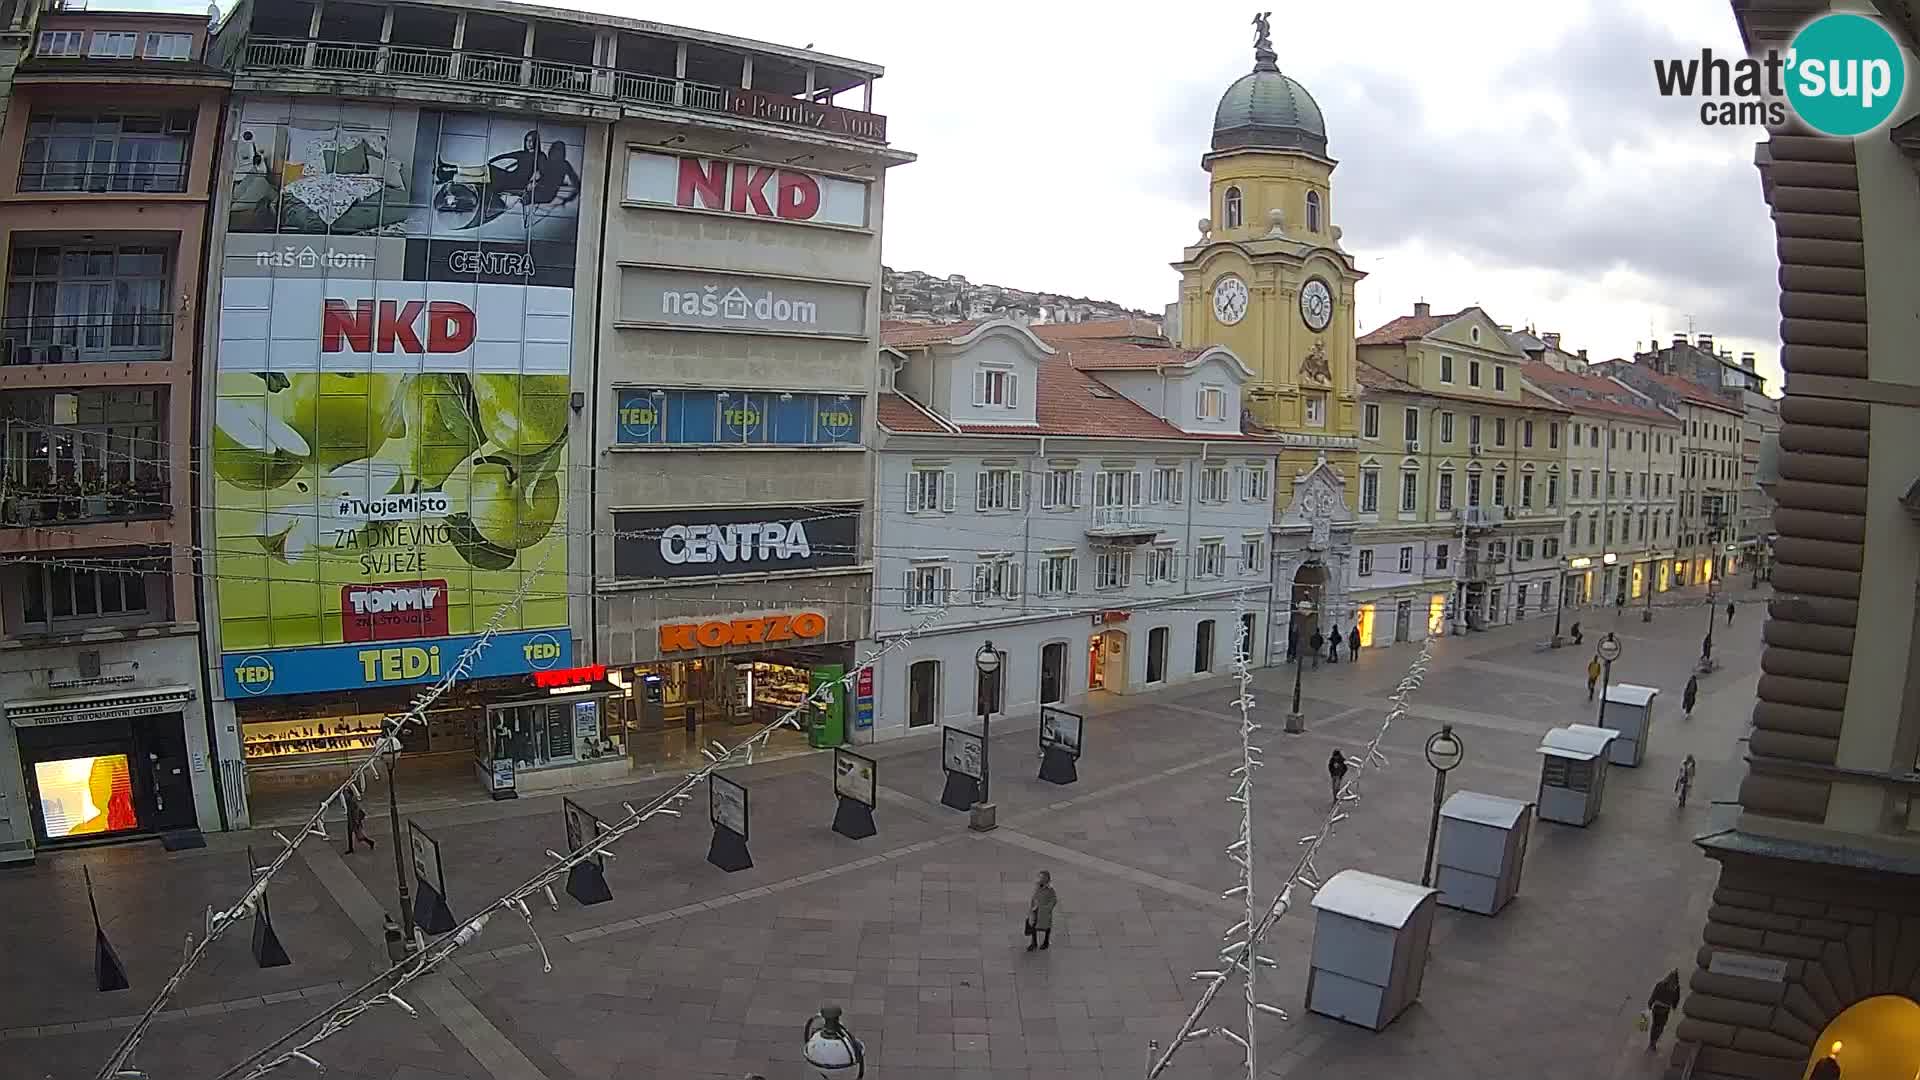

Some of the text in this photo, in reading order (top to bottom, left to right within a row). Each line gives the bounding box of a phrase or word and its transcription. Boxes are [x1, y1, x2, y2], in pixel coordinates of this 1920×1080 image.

[724, 90, 746, 112] Le
[676, 158, 821, 221] NKD
[256, 245, 367, 271] naš dom
[448, 250, 537, 277] CENTRA
[663, 284, 817, 324] naš dom
[321, 298, 478, 354] NKD
[619, 408, 658, 426] TEDi
[724, 408, 761, 426] TEDi
[820, 411, 853, 428] TEDi
[339, 496, 447, 517] #TvojeMisto
[335, 523, 451, 549] ZA DNEVNO
[660, 521, 811, 565] CENTRA
[360, 547, 428, 576] SVJEŽE
[350, 587, 438, 615] TOMMY
[658, 612, 826, 652] KORZO
[359, 645, 441, 683] TEDi
[523, 643, 560, 660] TEDi
[234, 666, 275, 684] TEDi
